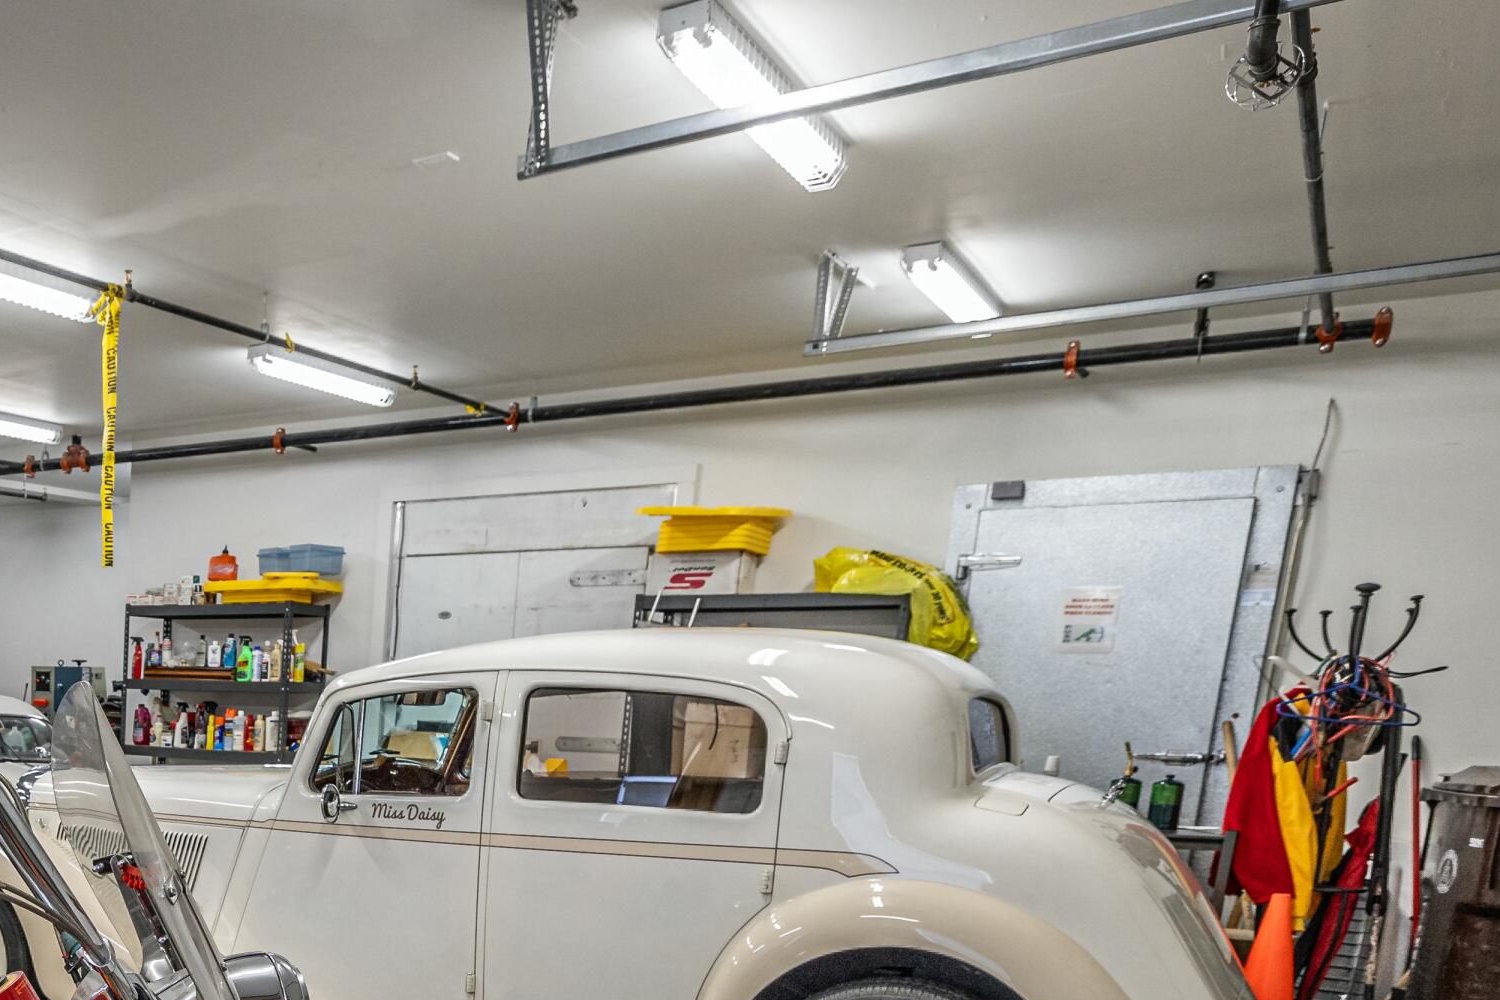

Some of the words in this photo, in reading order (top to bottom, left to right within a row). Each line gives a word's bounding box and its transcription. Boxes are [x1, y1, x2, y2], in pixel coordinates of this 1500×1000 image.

[104, 464, 114, 510] CAUTION
[104, 522, 114, 568] CAUTION
[372, 803, 405, 819] Miss
[407, 804, 446, 829] Daisy
